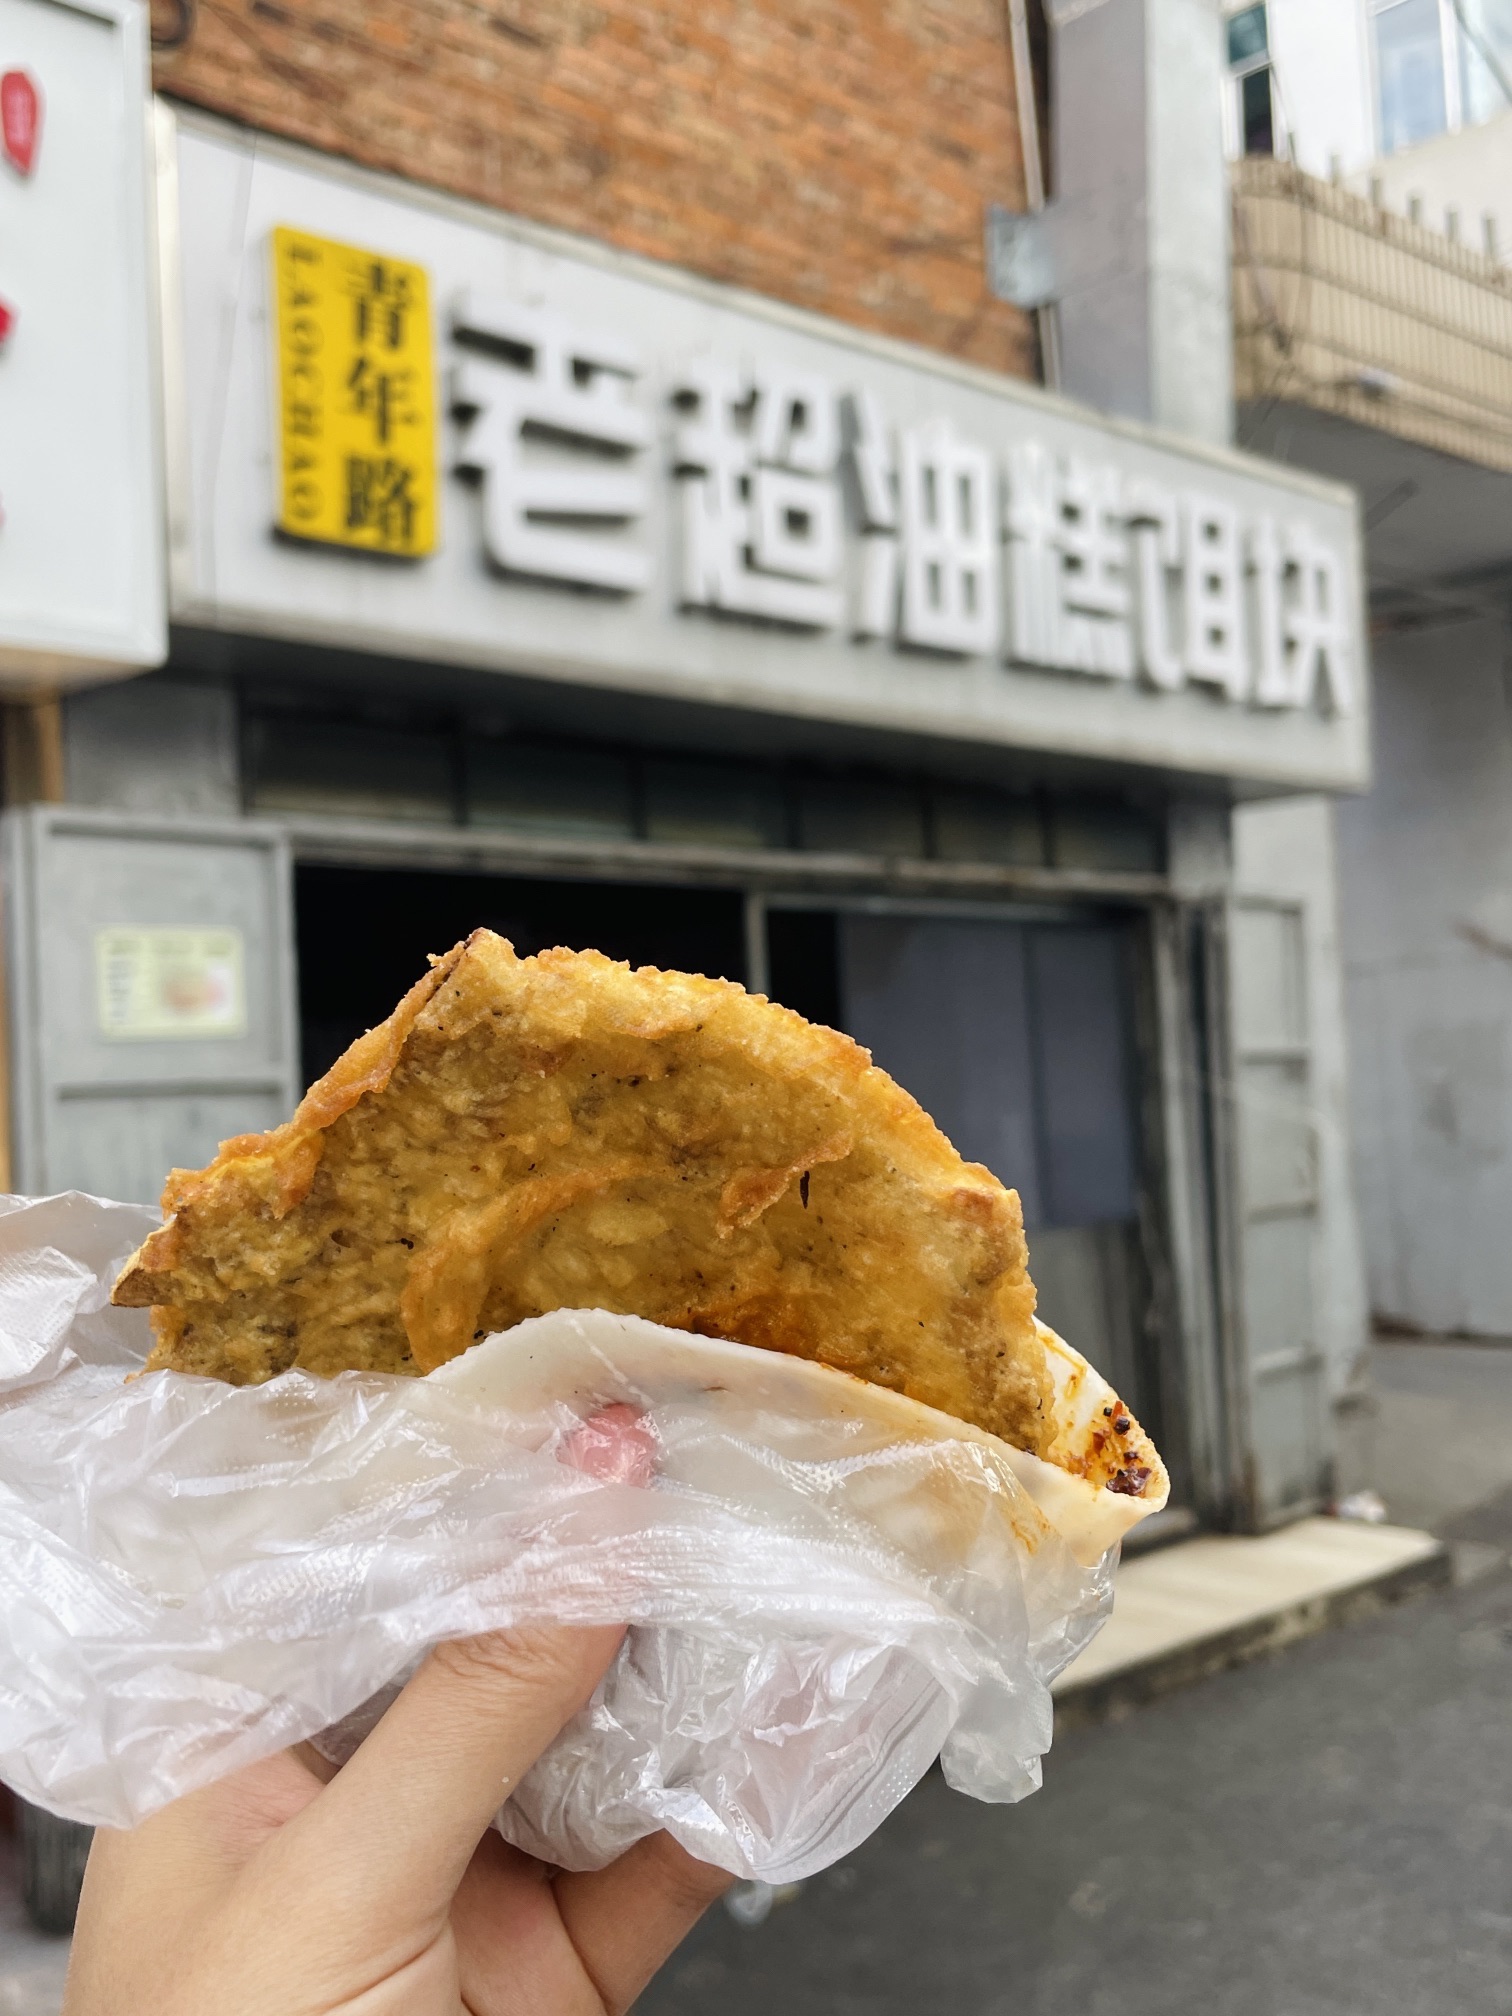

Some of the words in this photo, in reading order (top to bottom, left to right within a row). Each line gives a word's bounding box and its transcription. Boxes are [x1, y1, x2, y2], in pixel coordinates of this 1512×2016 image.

[344, 257, 422, 542] 青年路
[452, 304, 1352, 714] 老超油糕饵块
